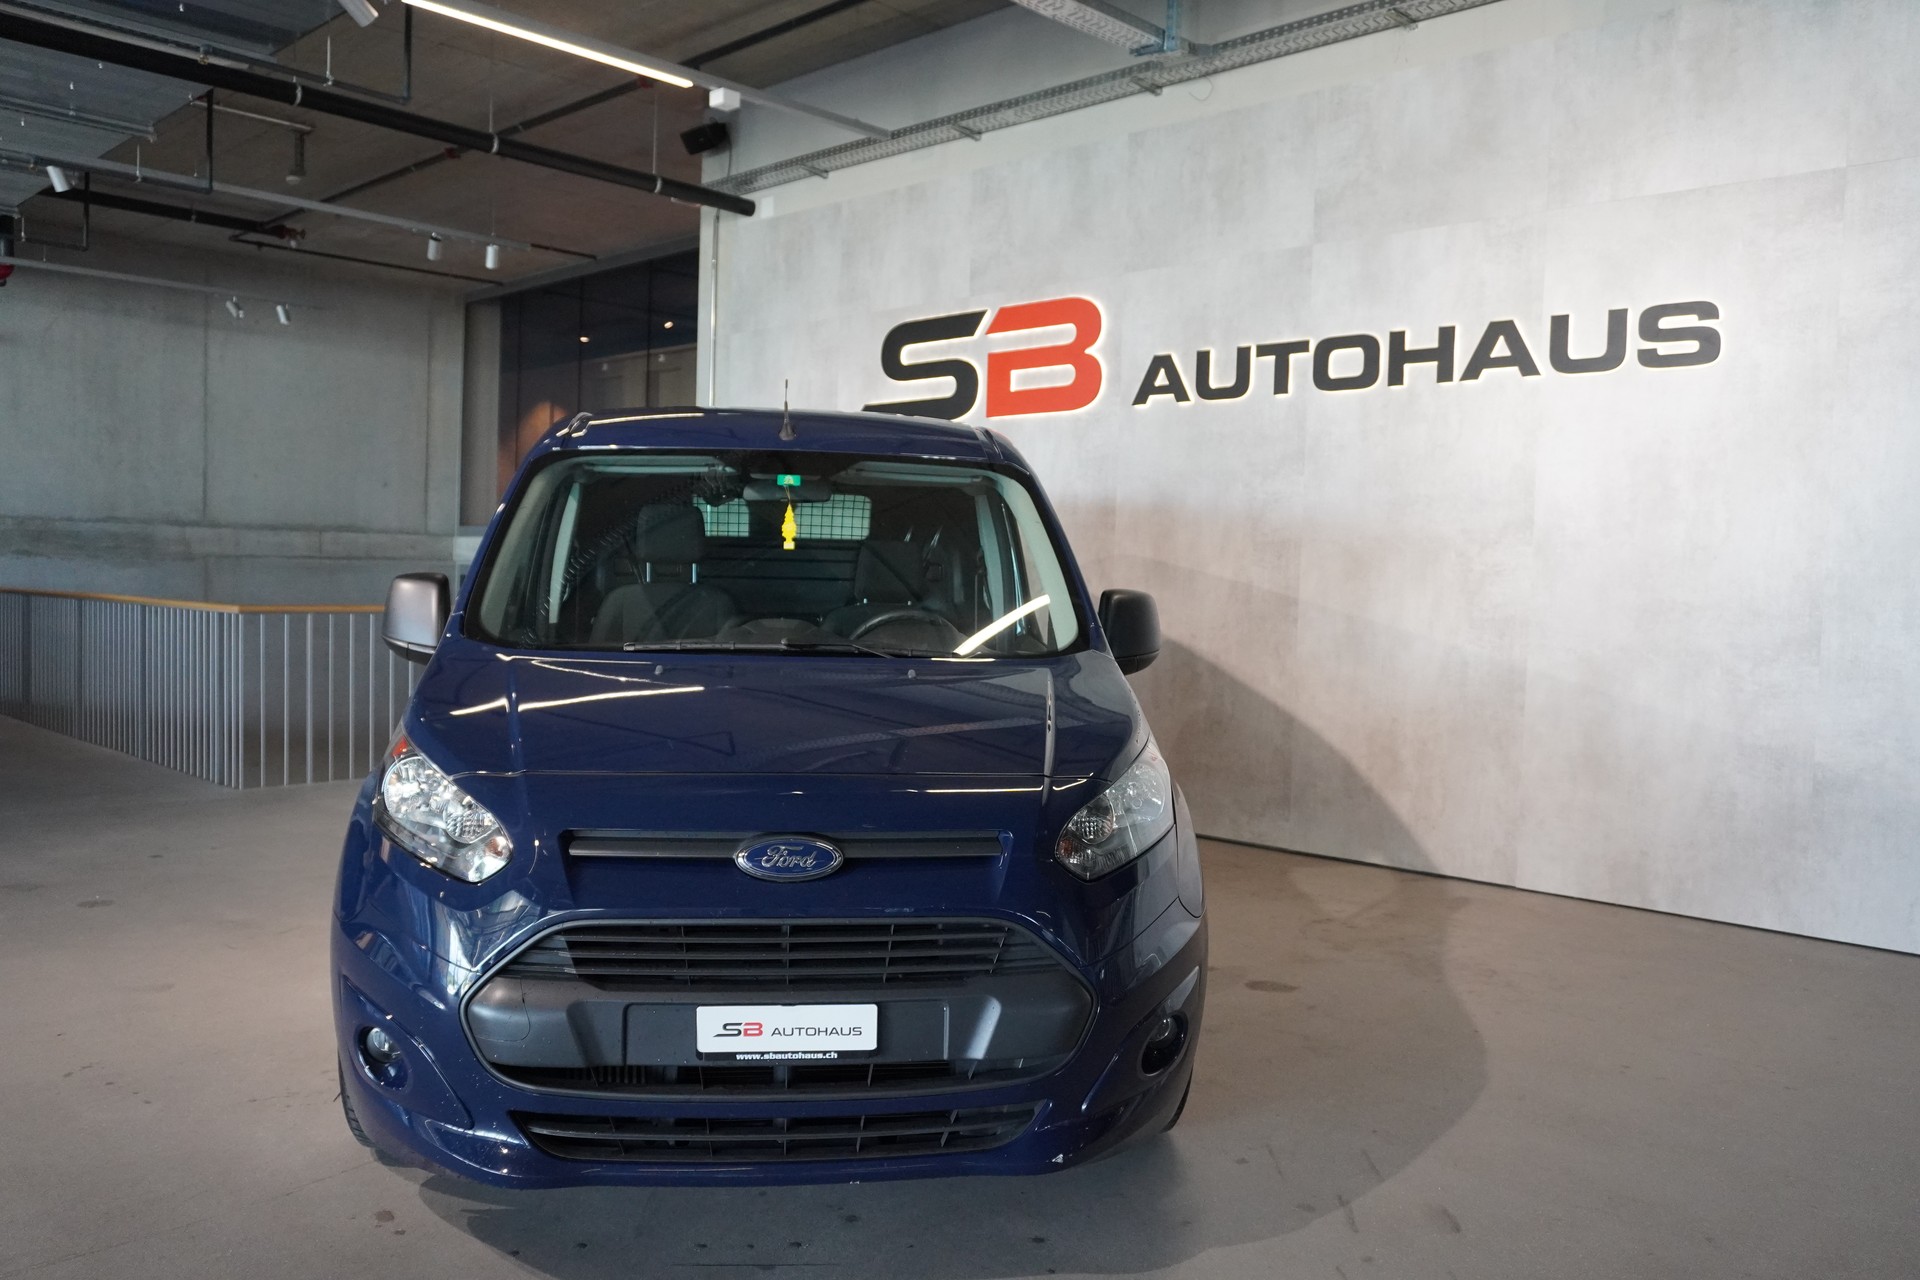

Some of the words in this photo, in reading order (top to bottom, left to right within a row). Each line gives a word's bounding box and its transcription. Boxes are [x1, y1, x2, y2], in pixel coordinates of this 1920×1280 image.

[862, 296, 1102, 420] SB
[1132, 300, 1721, 406] AUTOHAUS
[760, 845, 818, 868] Ford
[713, 1022, 763, 1037] SB
[771, 1026, 862, 1036] AUTOHAUS
[736, 1051, 837, 1060] www.sbautohaus.ch
